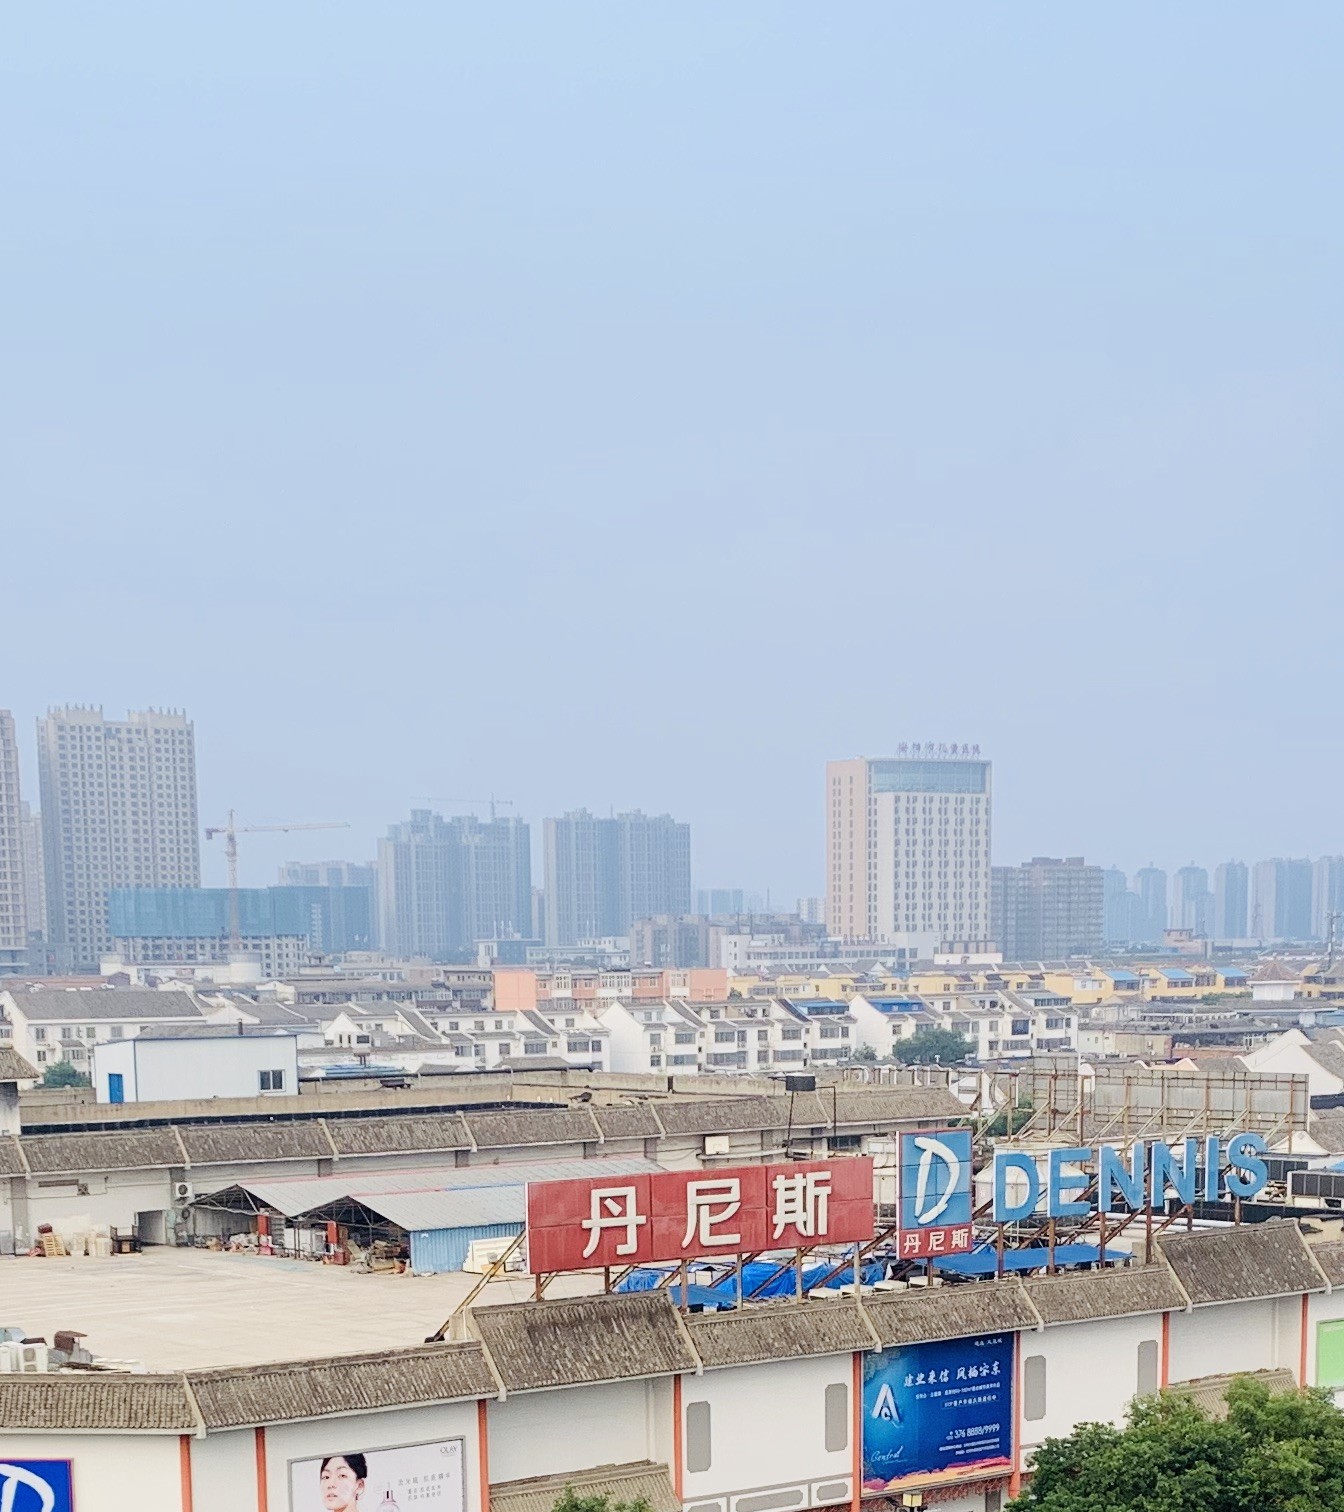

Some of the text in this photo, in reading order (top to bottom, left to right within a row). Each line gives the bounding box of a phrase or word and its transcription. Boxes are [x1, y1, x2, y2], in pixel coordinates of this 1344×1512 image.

[581, 1170, 832, 1259] 丹尼斯
[994, 1131, 1268, 1222] DENNIS
[903, 1227, 971, 1255] 丹尼斯
